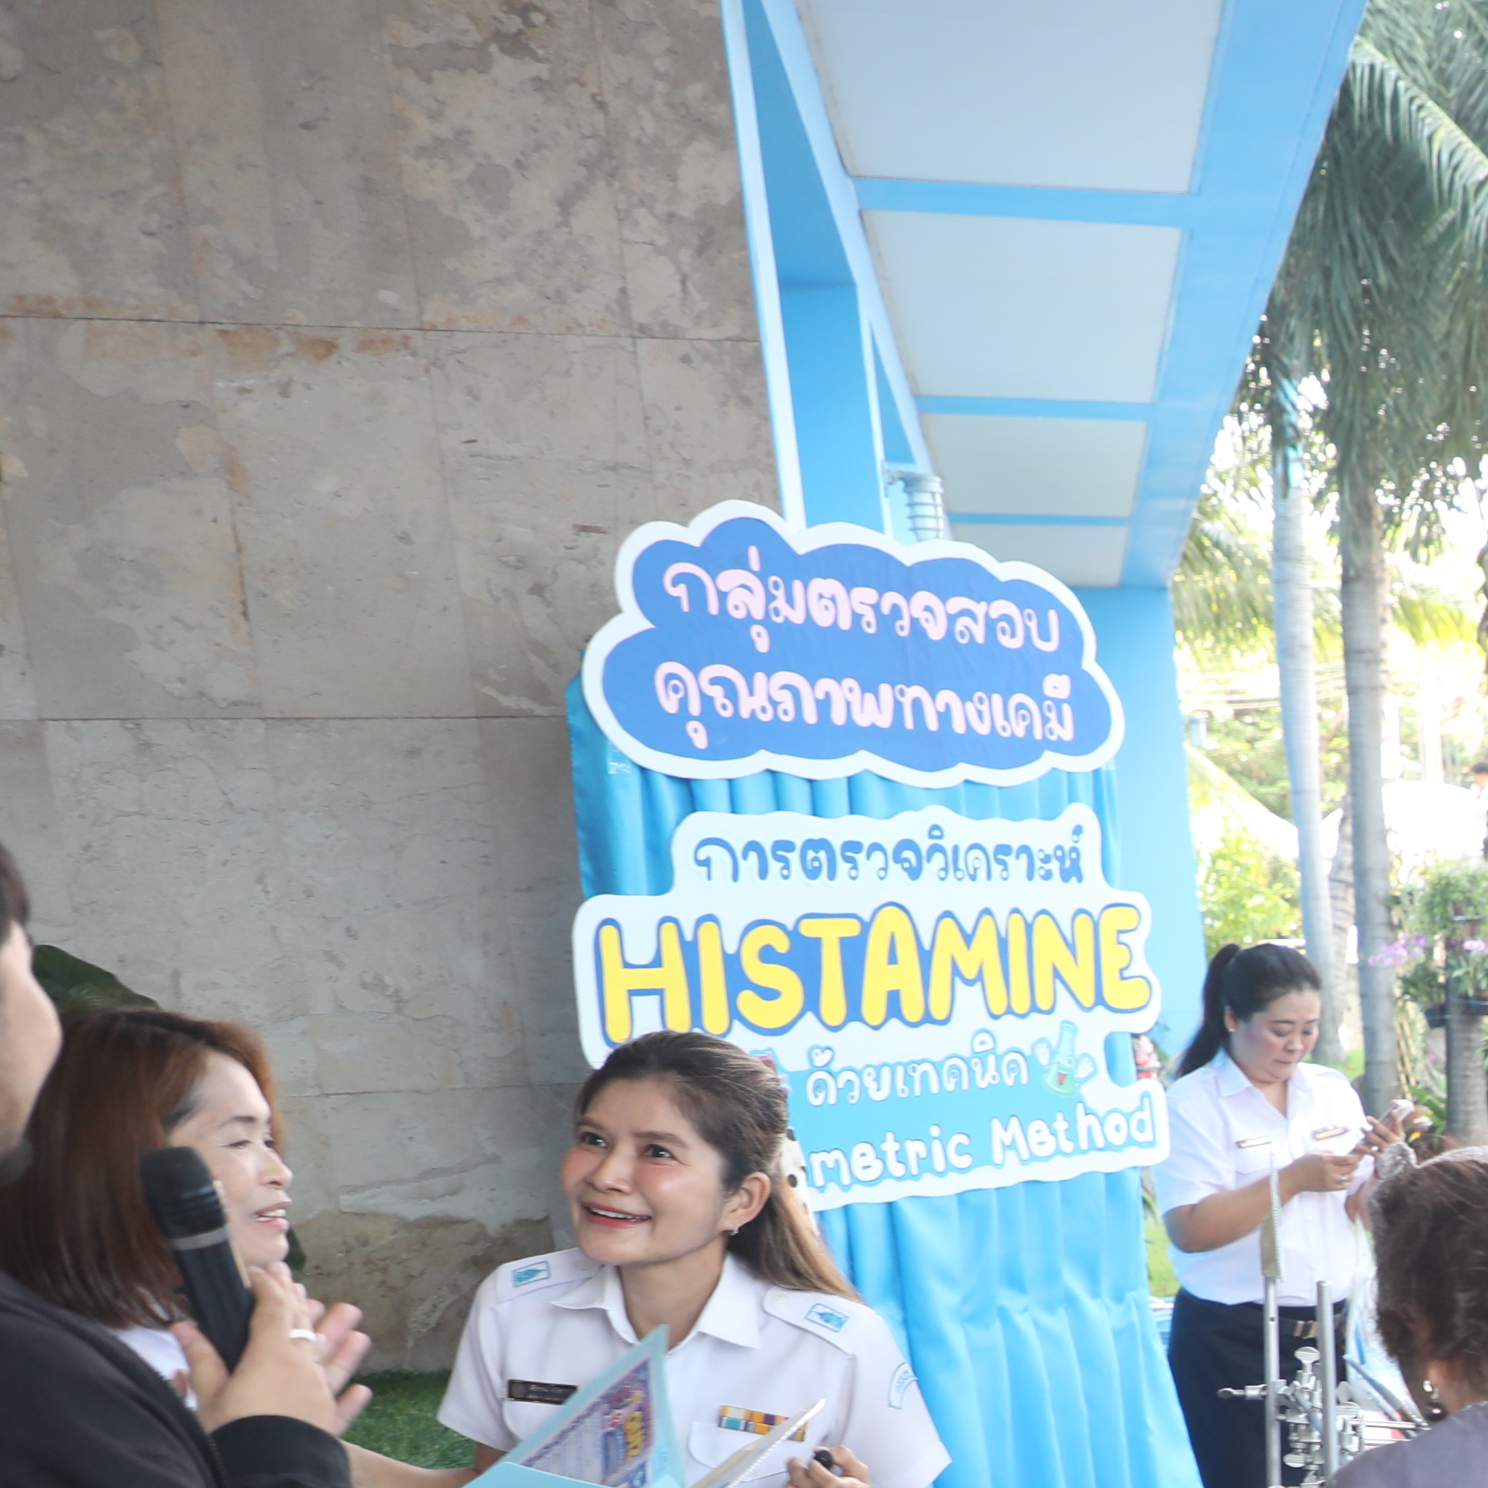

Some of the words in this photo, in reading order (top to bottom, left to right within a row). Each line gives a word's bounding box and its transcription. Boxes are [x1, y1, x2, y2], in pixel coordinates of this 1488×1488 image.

[662, 544, 1061, 654] กลุ่มตรวจสอบ
[653, 660, 1075, 750] คุณภาพทางเคมี
[693, 823, 1084, 884] การตรวจวิเคราะห์
[597, 903, 1154, 1045] HISTAMINE
[805, 1030, 1029, 1107] ด้วยเทคนิค
[990, 1096, 1155, 1166] Method
